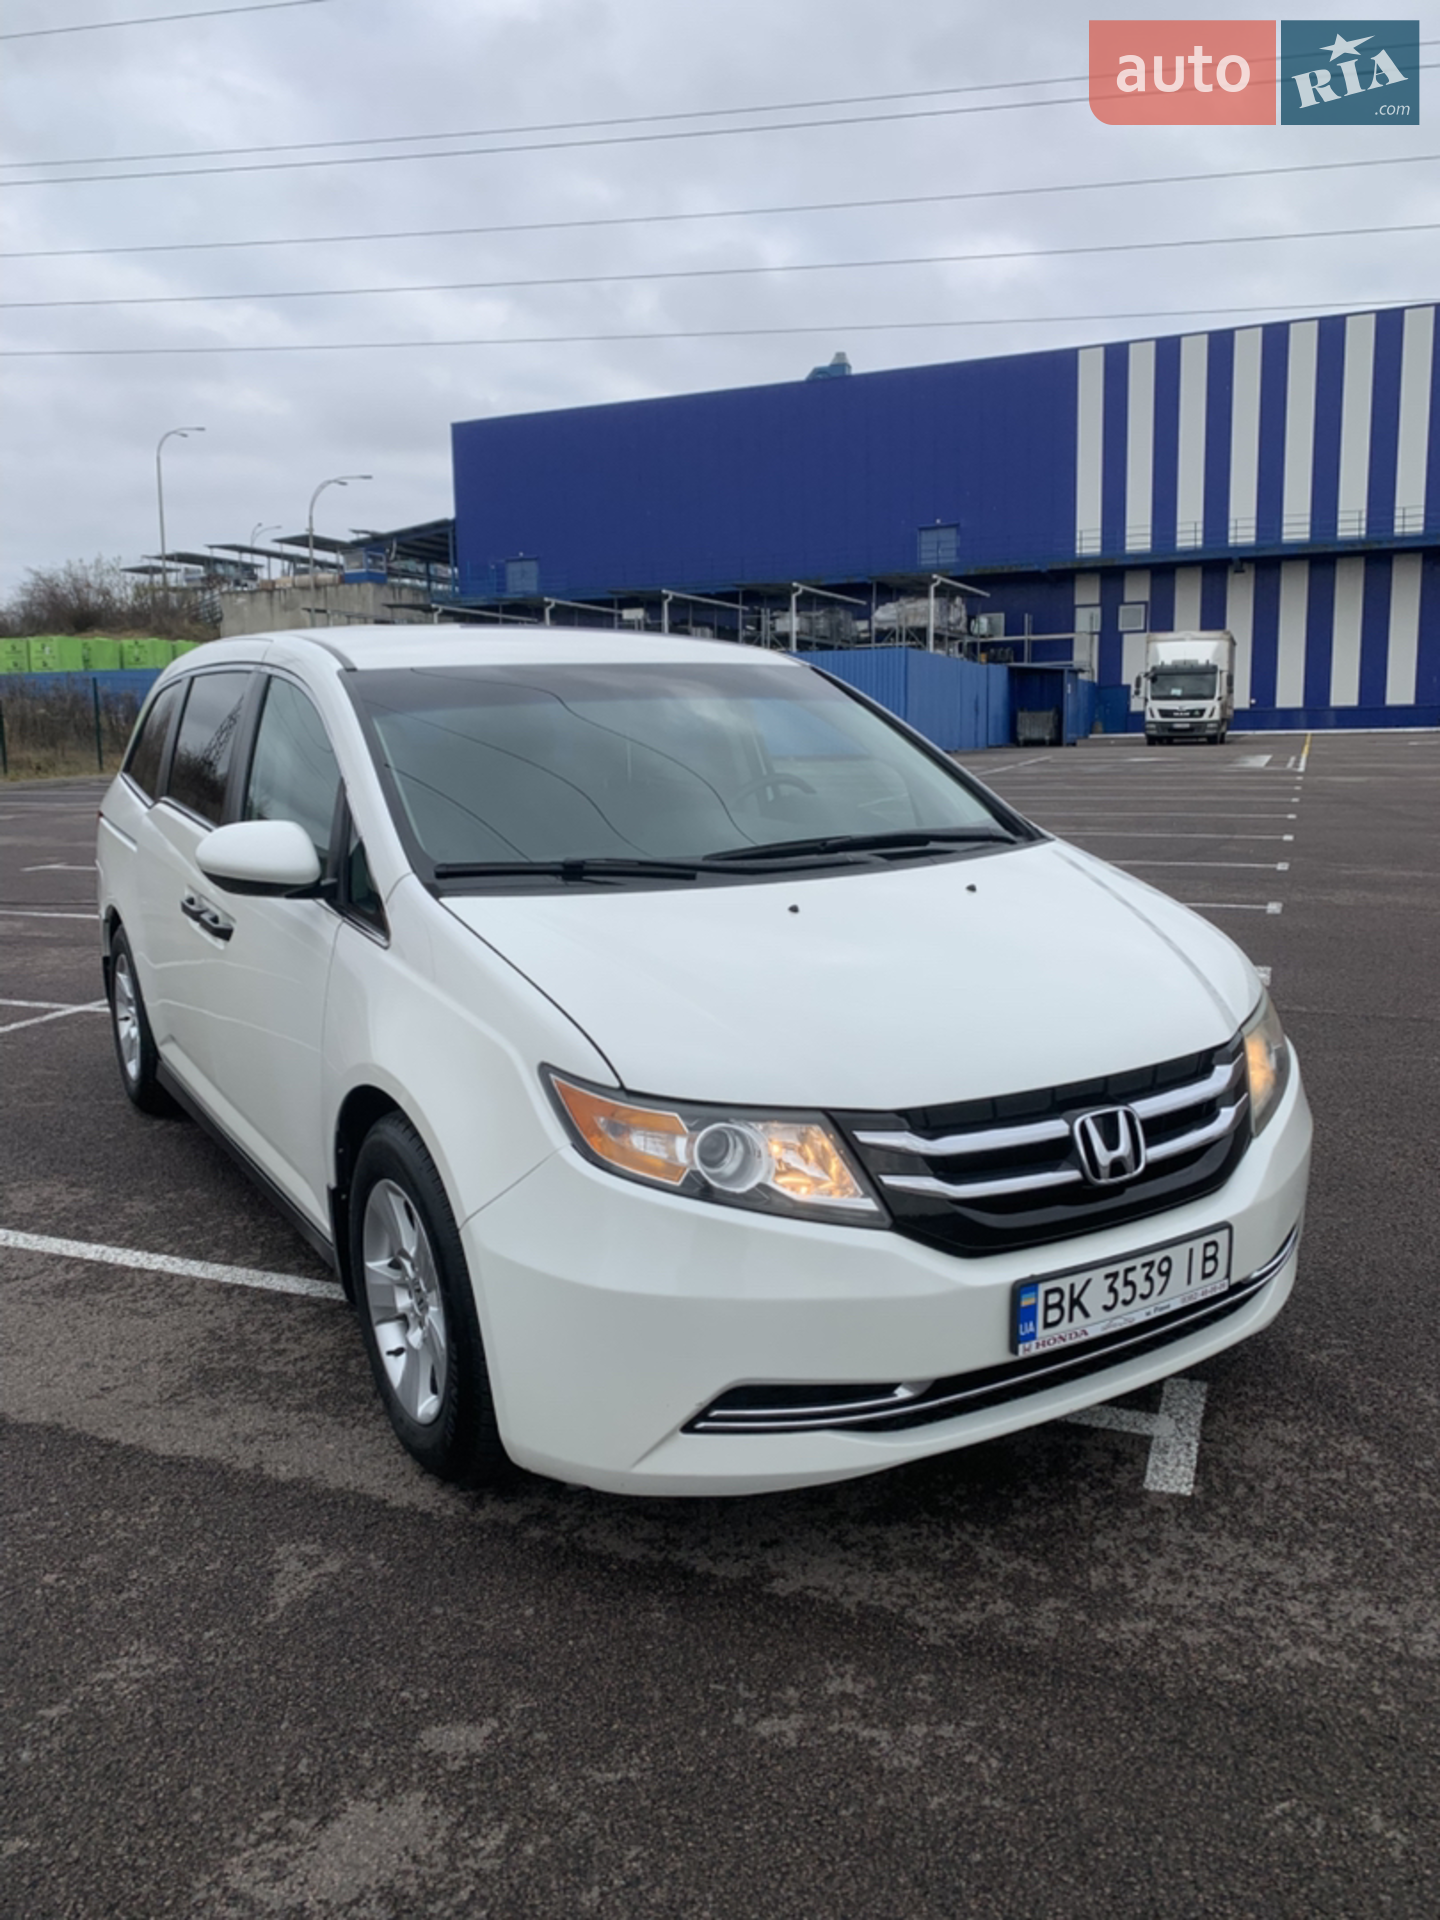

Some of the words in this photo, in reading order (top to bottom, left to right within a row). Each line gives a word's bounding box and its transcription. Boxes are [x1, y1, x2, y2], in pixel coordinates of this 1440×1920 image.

[1042, 1277, 1092, 1330] BK
[1102, 1255, 1173, 1312] 3539
[1186, 1239, 1219, 1287] IB
[1018, 1320, 1036, 1336] UA
[1034, 1328, 1089, 1350] HONDA
